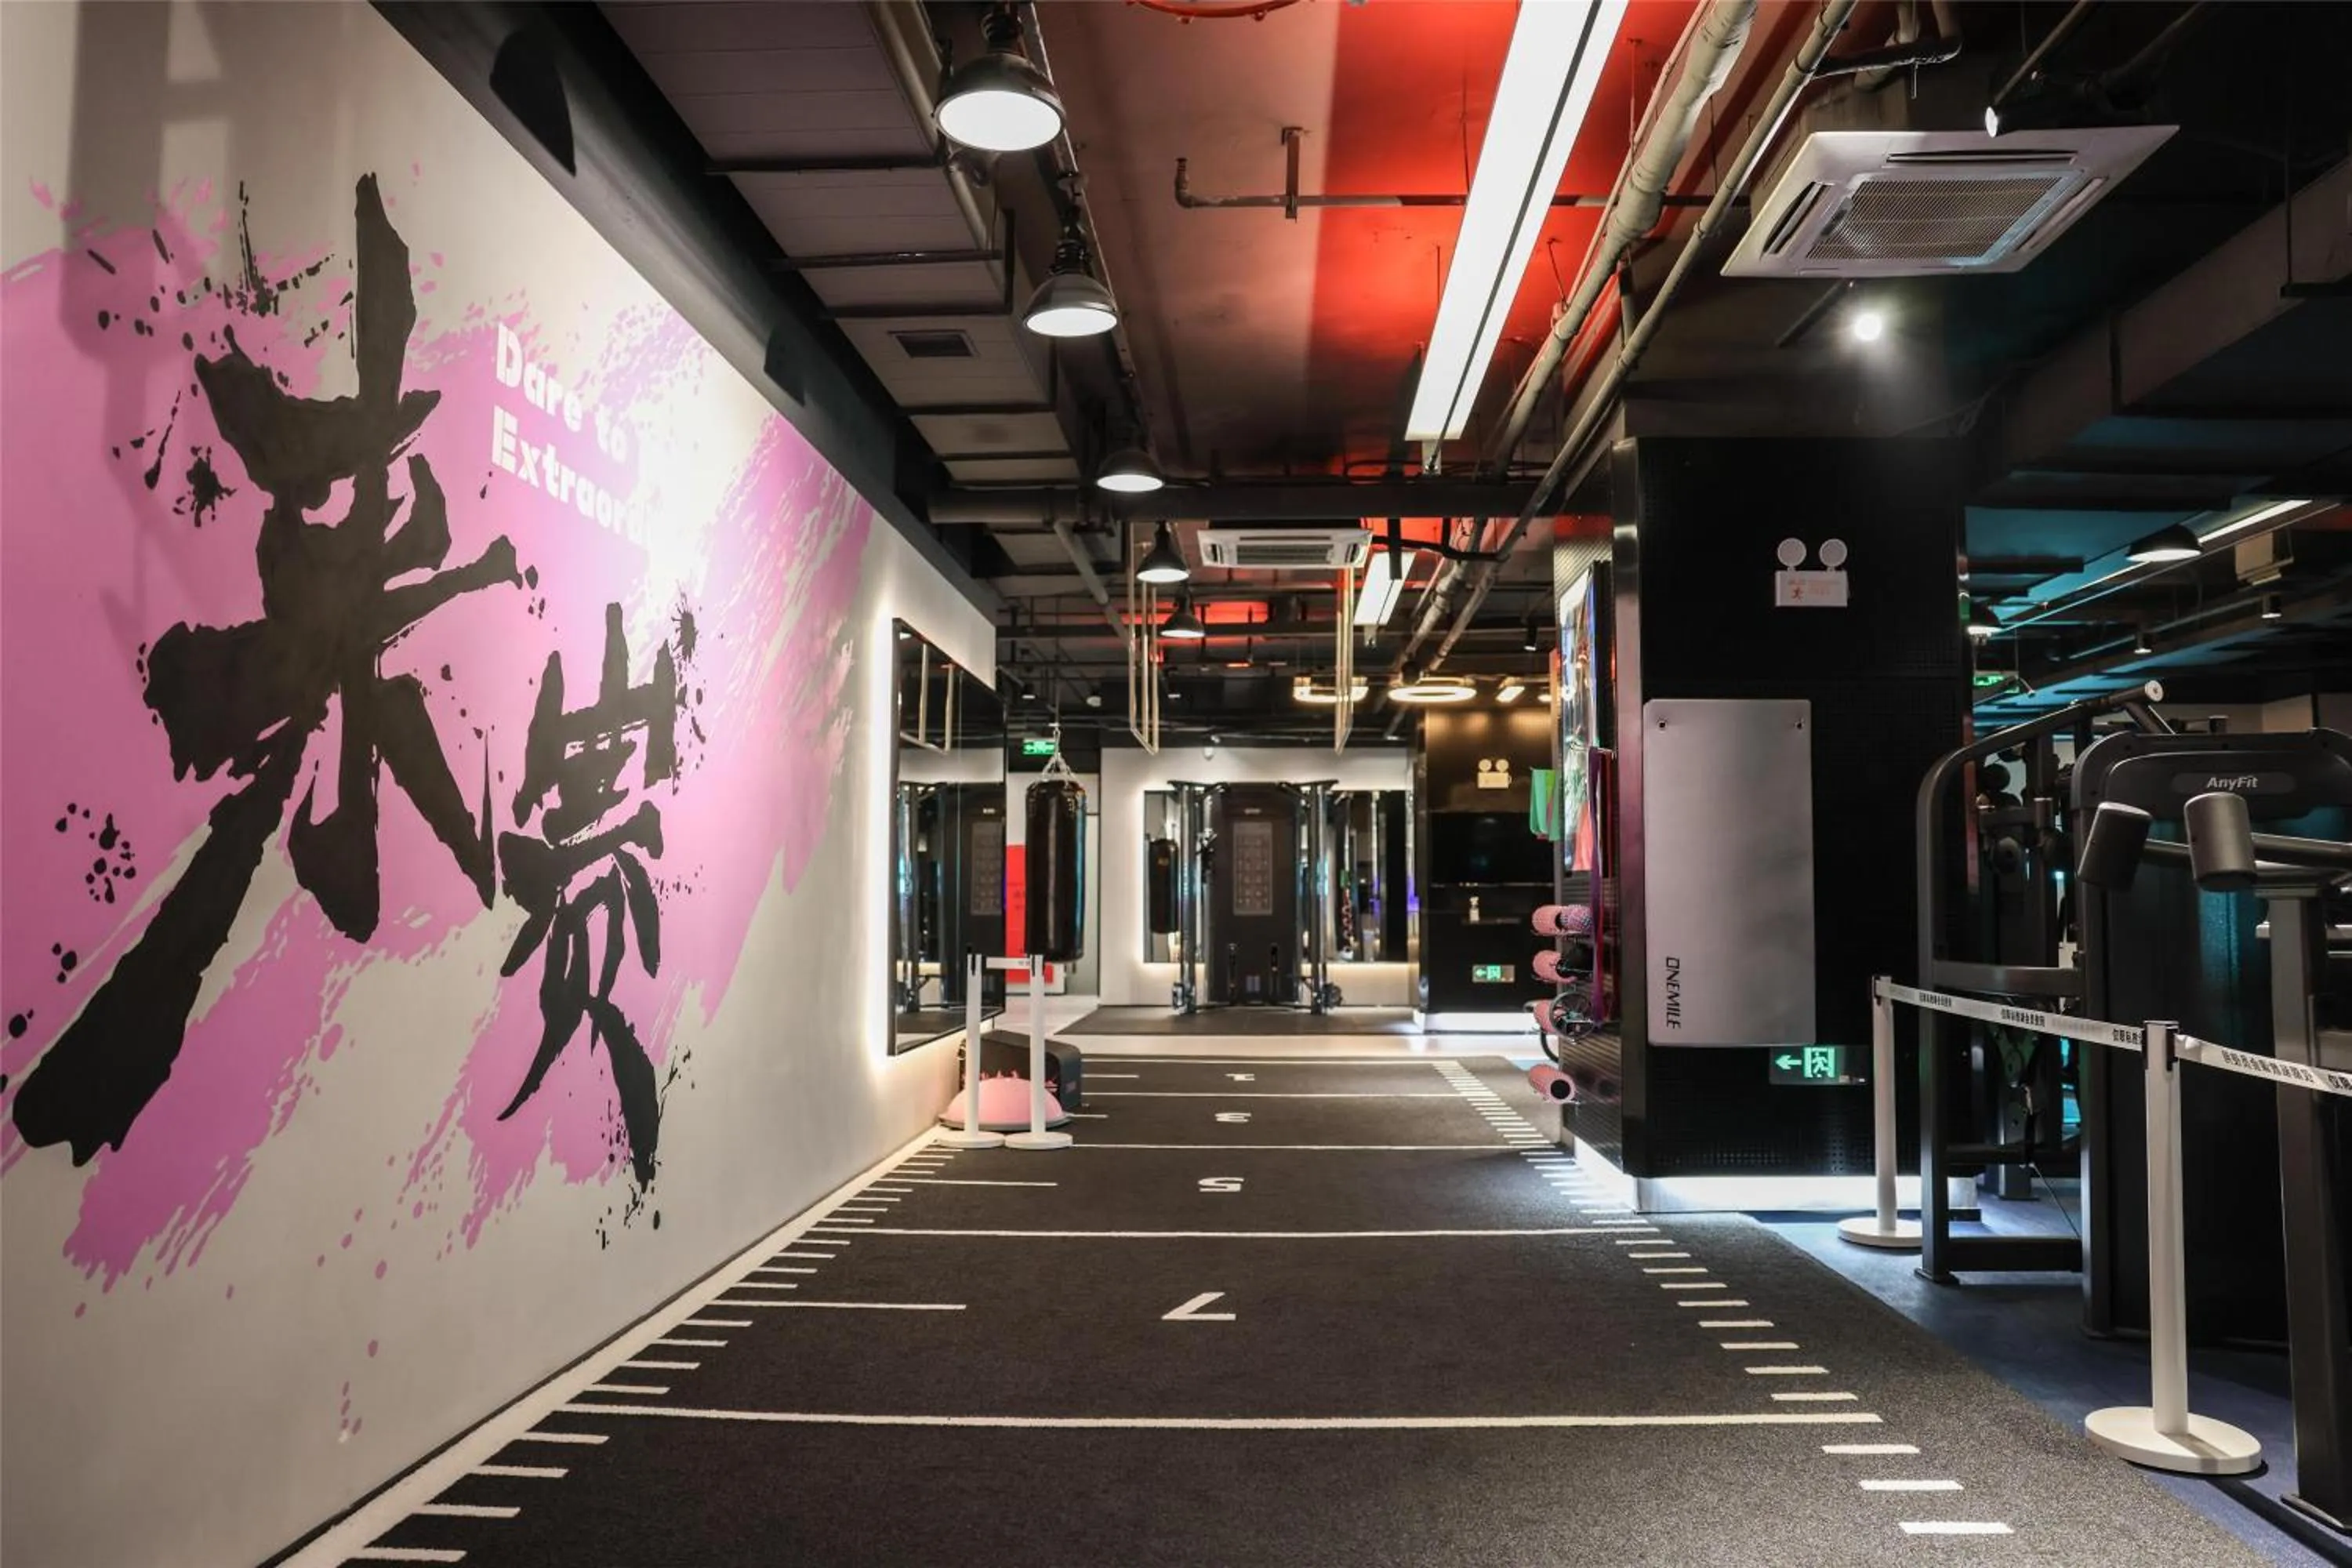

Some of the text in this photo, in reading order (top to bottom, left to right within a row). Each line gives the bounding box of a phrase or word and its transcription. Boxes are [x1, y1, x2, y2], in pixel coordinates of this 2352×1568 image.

[496, 322, 627, 464] Dare to
[2207, 776, 2259, 791] AnyFit
[1666, 956, 1681, 1029] ONEMILE
[1161, 1291, 1236, 1321] 7
